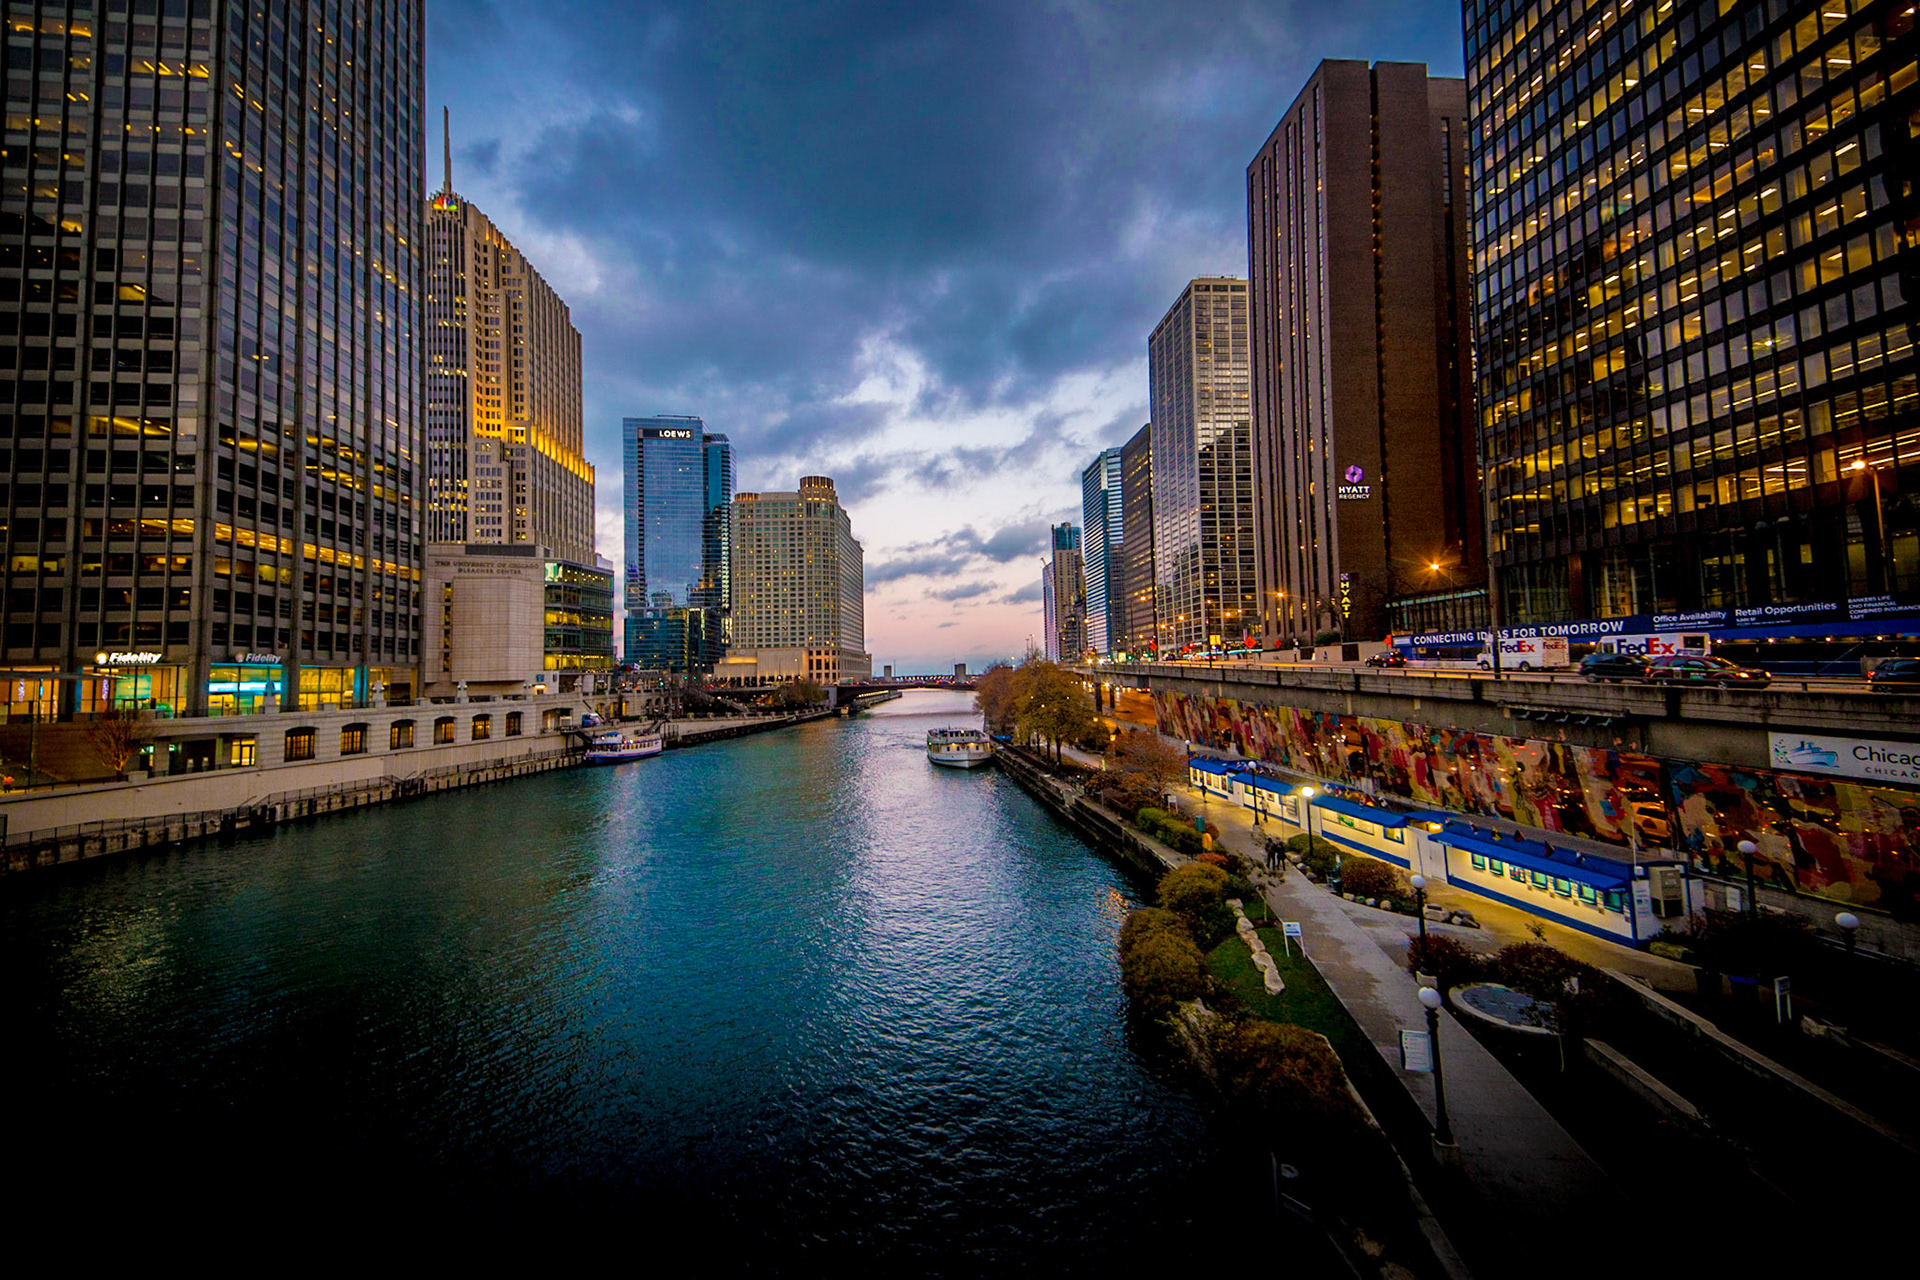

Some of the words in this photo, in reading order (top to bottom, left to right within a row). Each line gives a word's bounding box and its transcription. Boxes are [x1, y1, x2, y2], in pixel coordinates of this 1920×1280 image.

[659, 430, 691, 438] LOEWS
[1338, 486, 1370, 494] HYATT
[1340, 581, 1351, 618] HYATT
[1734, 607, 1763, 617] Retail
[1764, 601, 1838, 616] Opportunities
[1848, 607, 1883, 615] COMBINED
[1652, 614, 1678, 624] Office
[1679, 610, 1727, 621] Availability
[1413, 632, 1474, 645] CONNECTING
[1477, 629, 1509, 641] IDS
[1512, 628, 1537, 638] FOR
[1540, 620, 1624, 637] TOMORROW
[1500, 640, 1535, 653] FedEx
[1543, 641, 1567, 650] FedEx
[1617, 637, 1675, 655] FedEx
[109, 651, 162, 664] Fidelity
[245, 653, 281, 664] Fidelity
[1865, 766, 1919, 778] CHICAG
